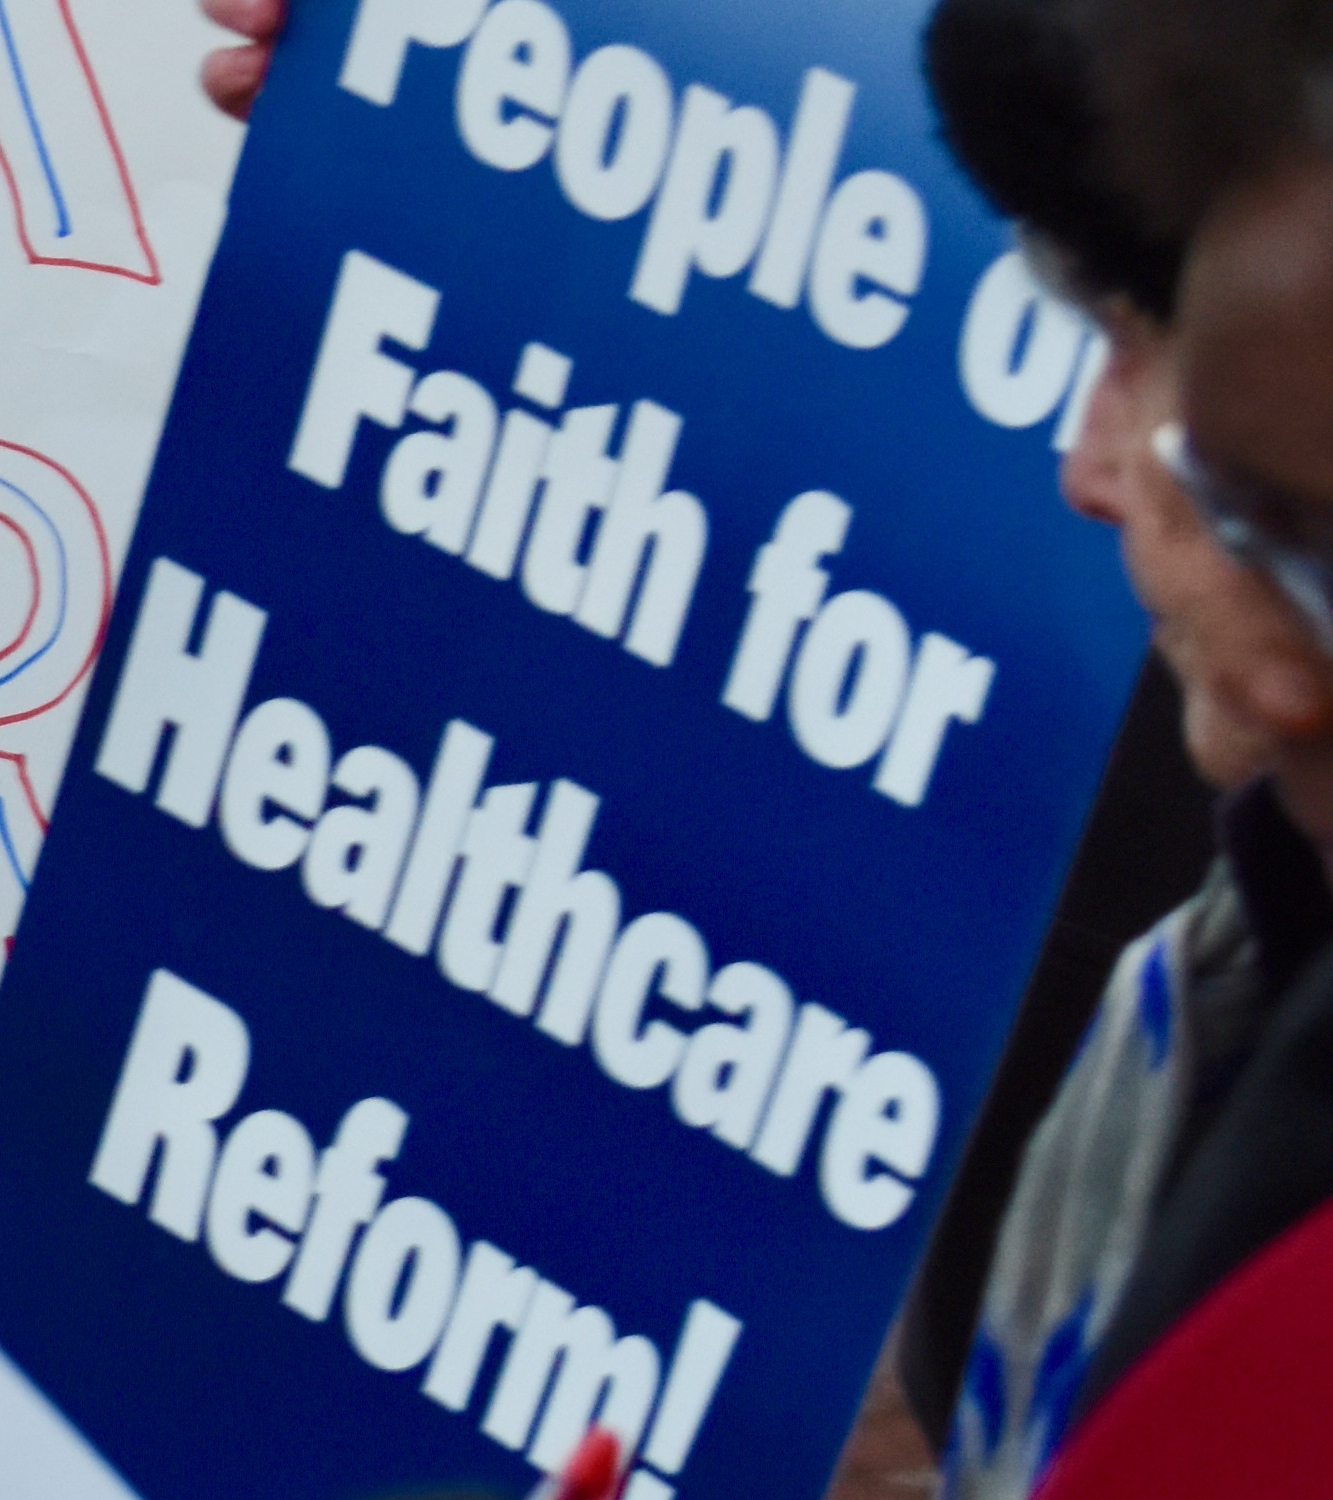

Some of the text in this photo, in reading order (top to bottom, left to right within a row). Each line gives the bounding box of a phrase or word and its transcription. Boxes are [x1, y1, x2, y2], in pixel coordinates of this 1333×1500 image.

[285, 248, 996, 808] Faith for
[92, 555, 941, 1232] Healthcare
